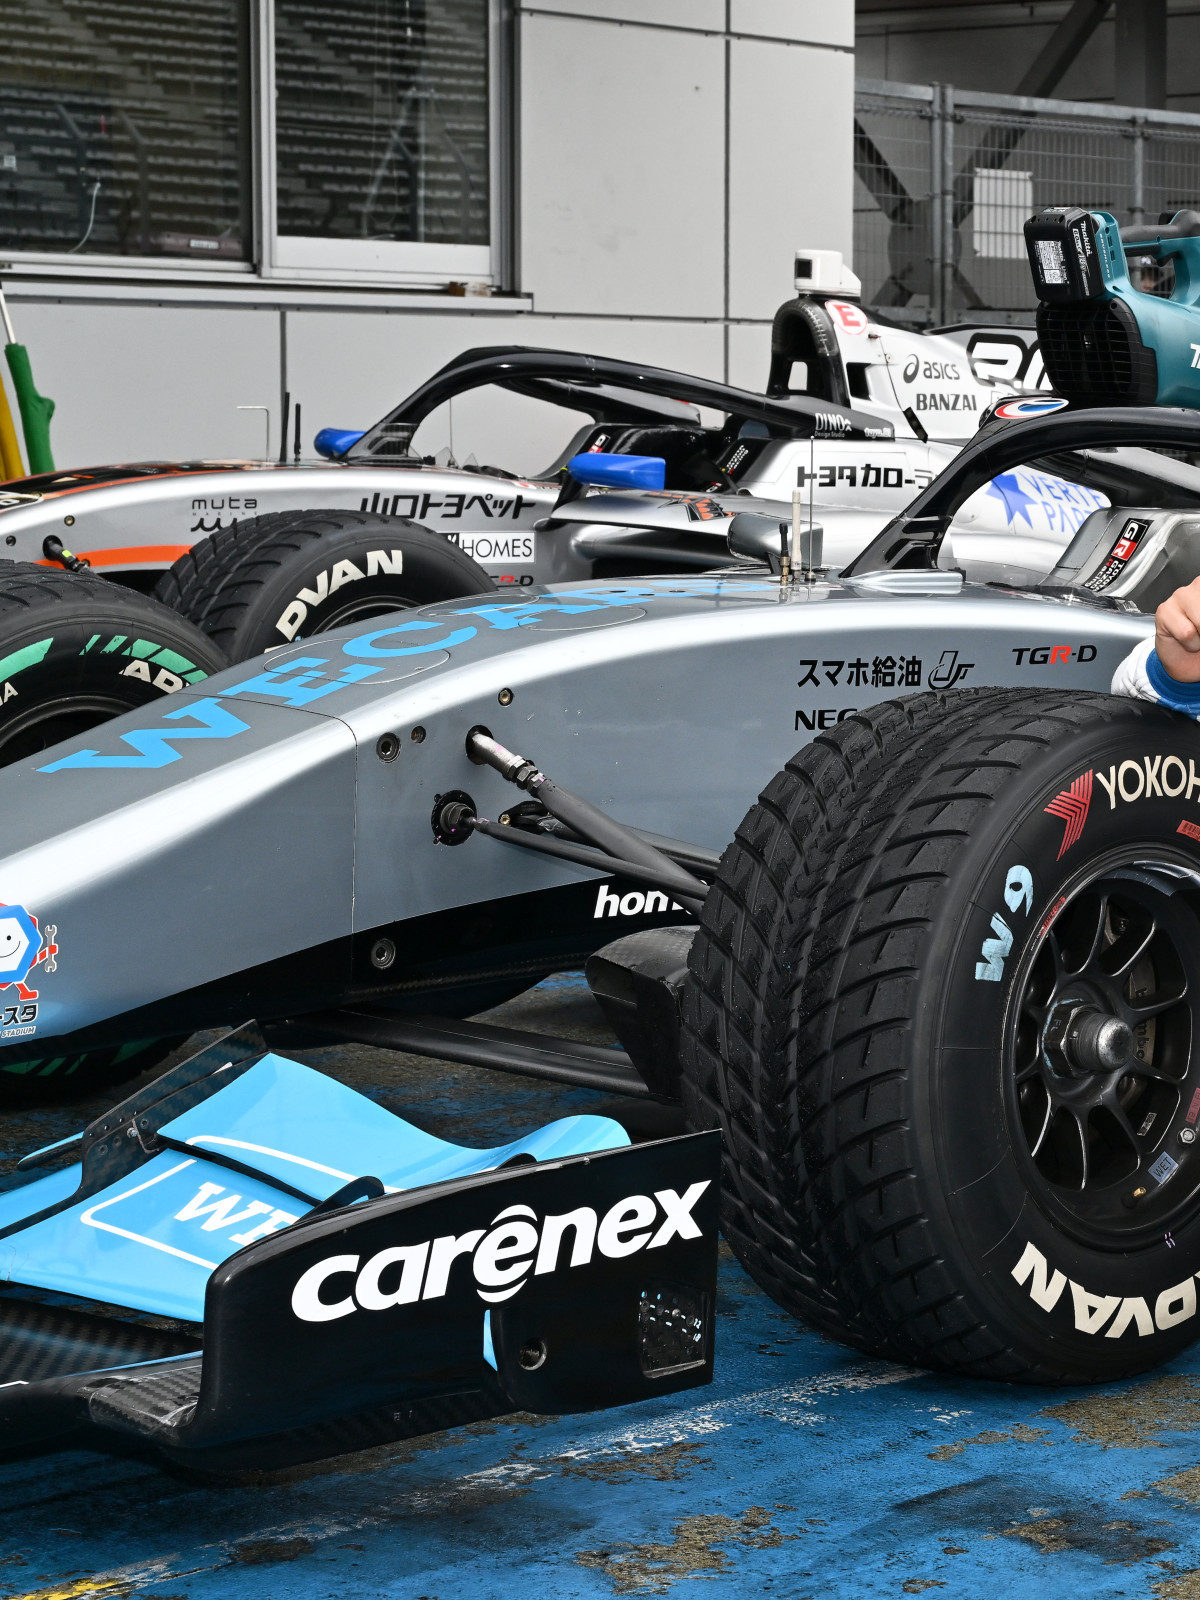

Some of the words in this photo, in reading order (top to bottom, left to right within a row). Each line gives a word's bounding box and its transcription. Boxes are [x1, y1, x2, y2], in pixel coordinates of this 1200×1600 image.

[837, 304, 861, 329] E
[923, 361, 961, 380] asics
[916, 393, 978, 411] BANZAI
[192, 496, 258, 510] muta
[461, 538, 534, 559] HOMES
[1012, 644, 1098, 666] TGR-D
[797, 655, 923, 689] スマホ給油
[1, 1026, 35, 1038] STADIUM
[1153, 1157, 1174, 1179] WET
[291, 1179, 712, 1323] carênex
